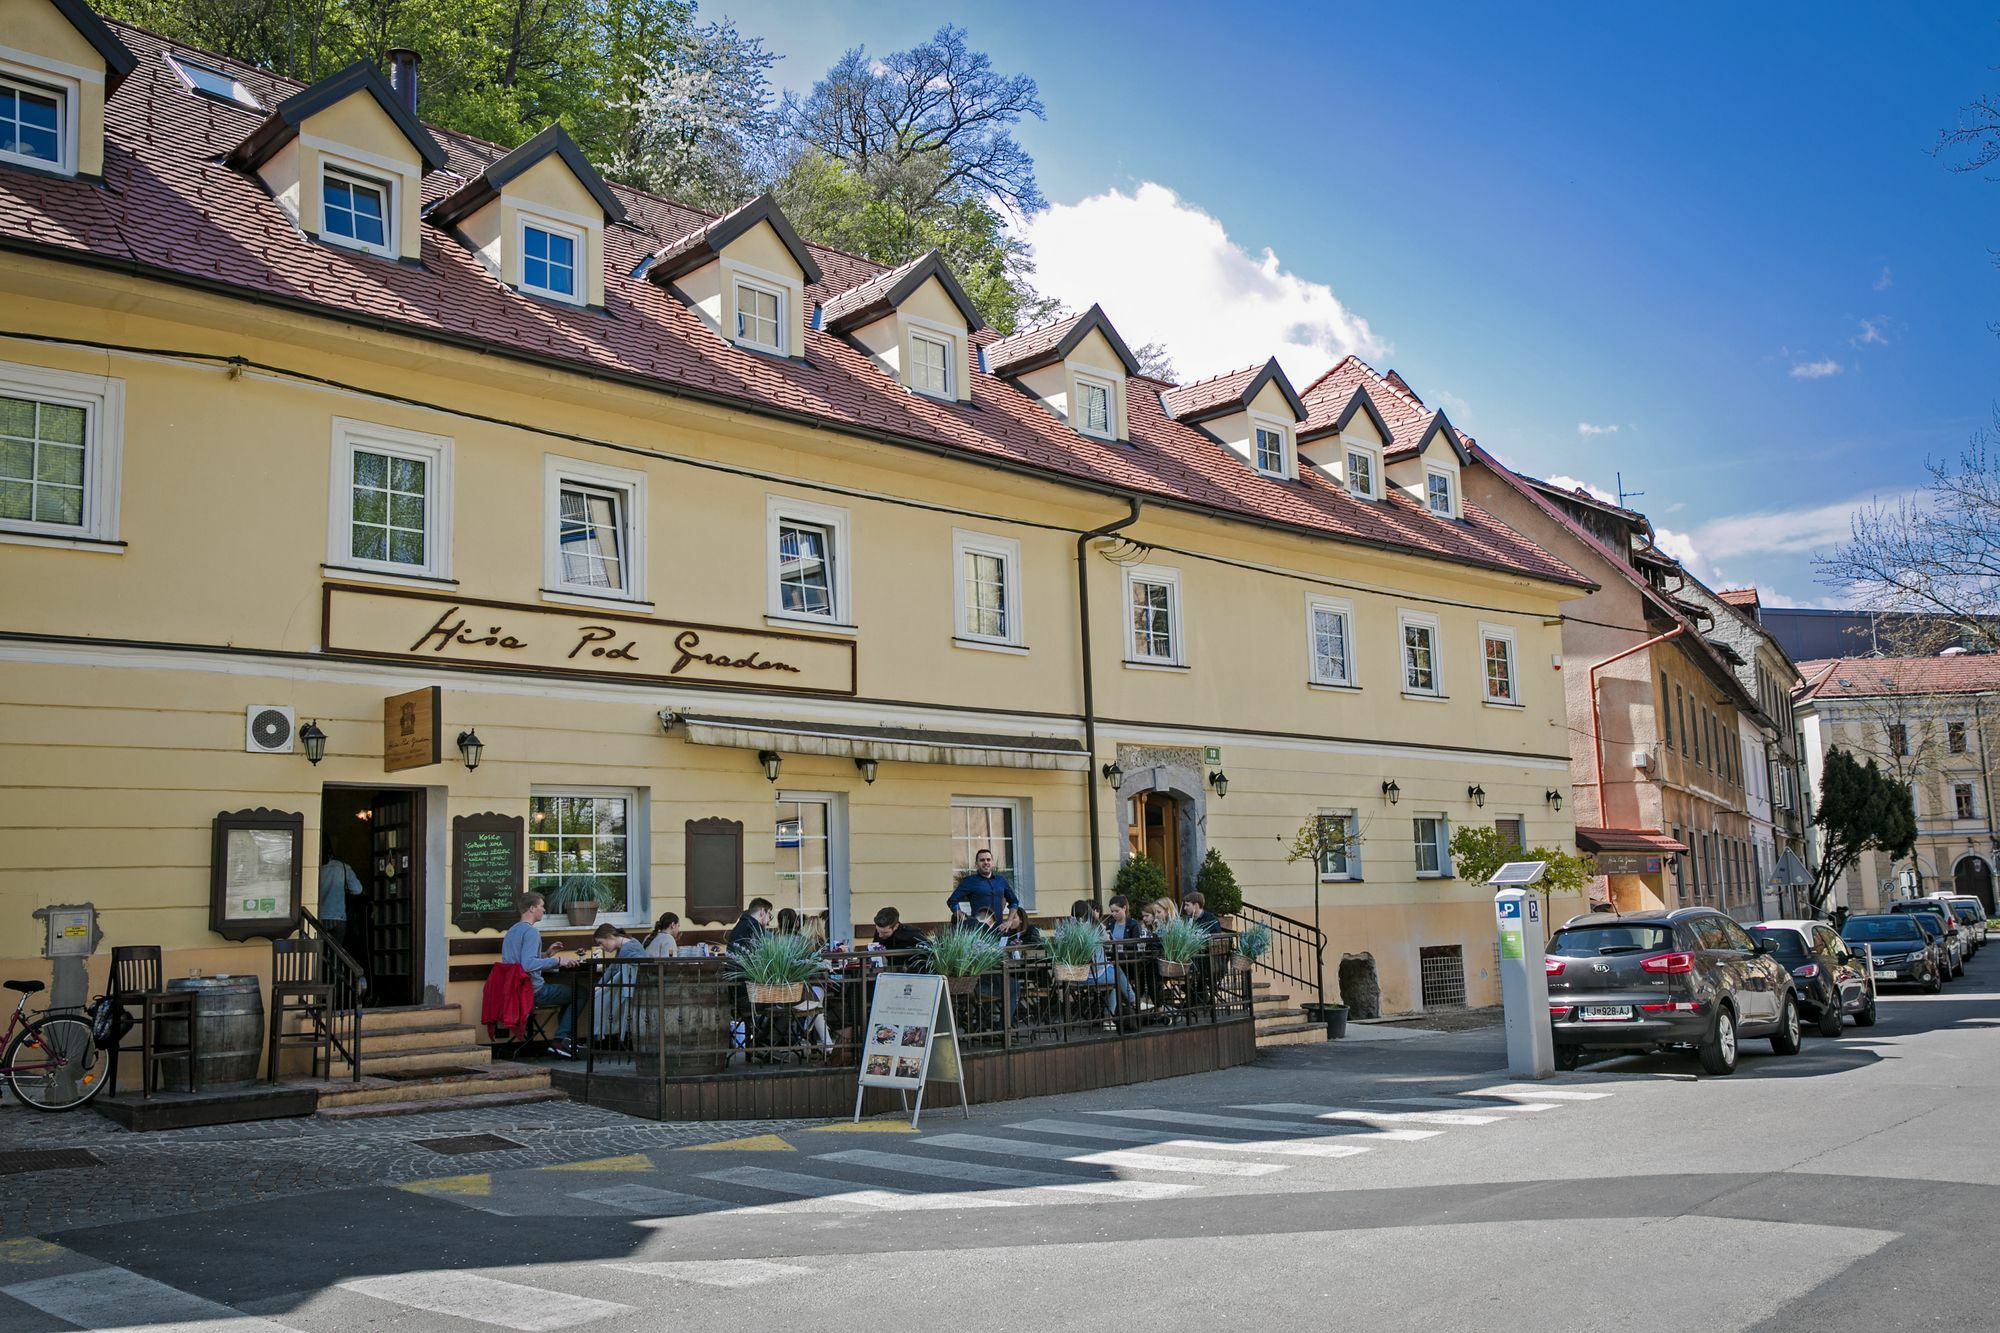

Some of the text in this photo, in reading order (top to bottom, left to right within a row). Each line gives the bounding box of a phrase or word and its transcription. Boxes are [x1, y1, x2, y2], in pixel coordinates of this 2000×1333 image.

[410, 606, 801, 674] Hiša Pod Gradom
[1504, 903, 1515, 914] P
[1594, 964, 1608, 972] KIA
